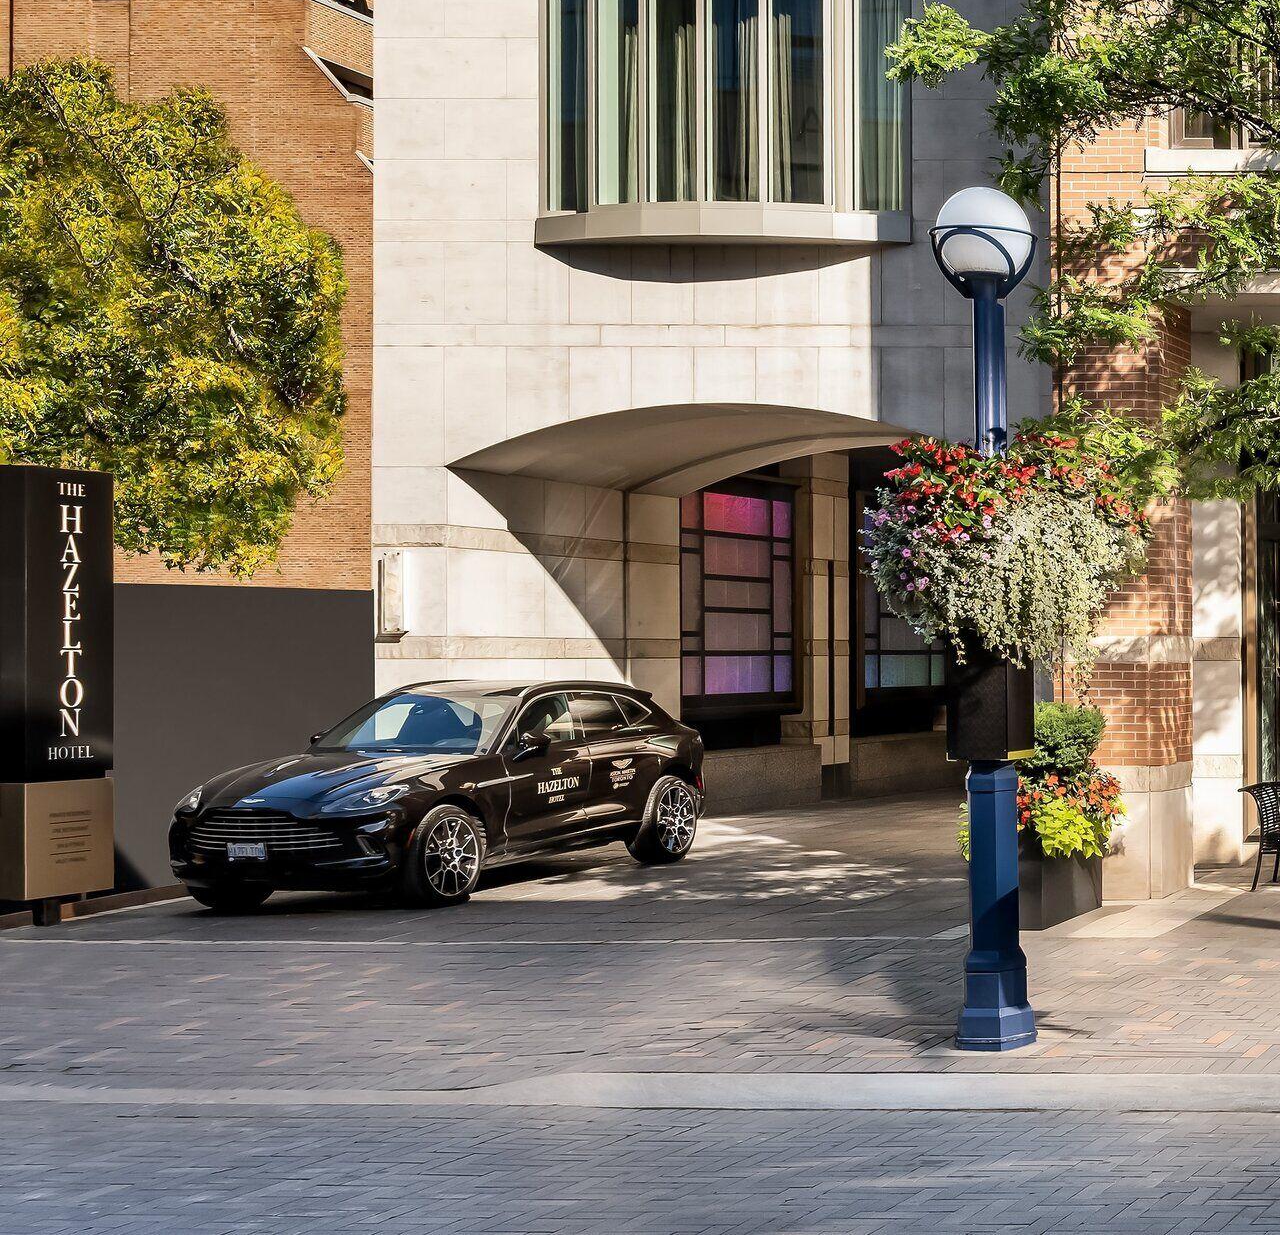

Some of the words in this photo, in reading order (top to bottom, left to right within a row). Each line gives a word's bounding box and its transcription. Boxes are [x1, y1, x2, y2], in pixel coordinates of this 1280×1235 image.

[57, 481, 87, 497] THE
[59, 504, 84, 737] HAZELTON
[48, 745, 94, 761] HOTEL
[551, 767, 563, 776] THE
[537, 776, 580, 795] HAZELTON
[548, 794, 565, 804] HOTEL
